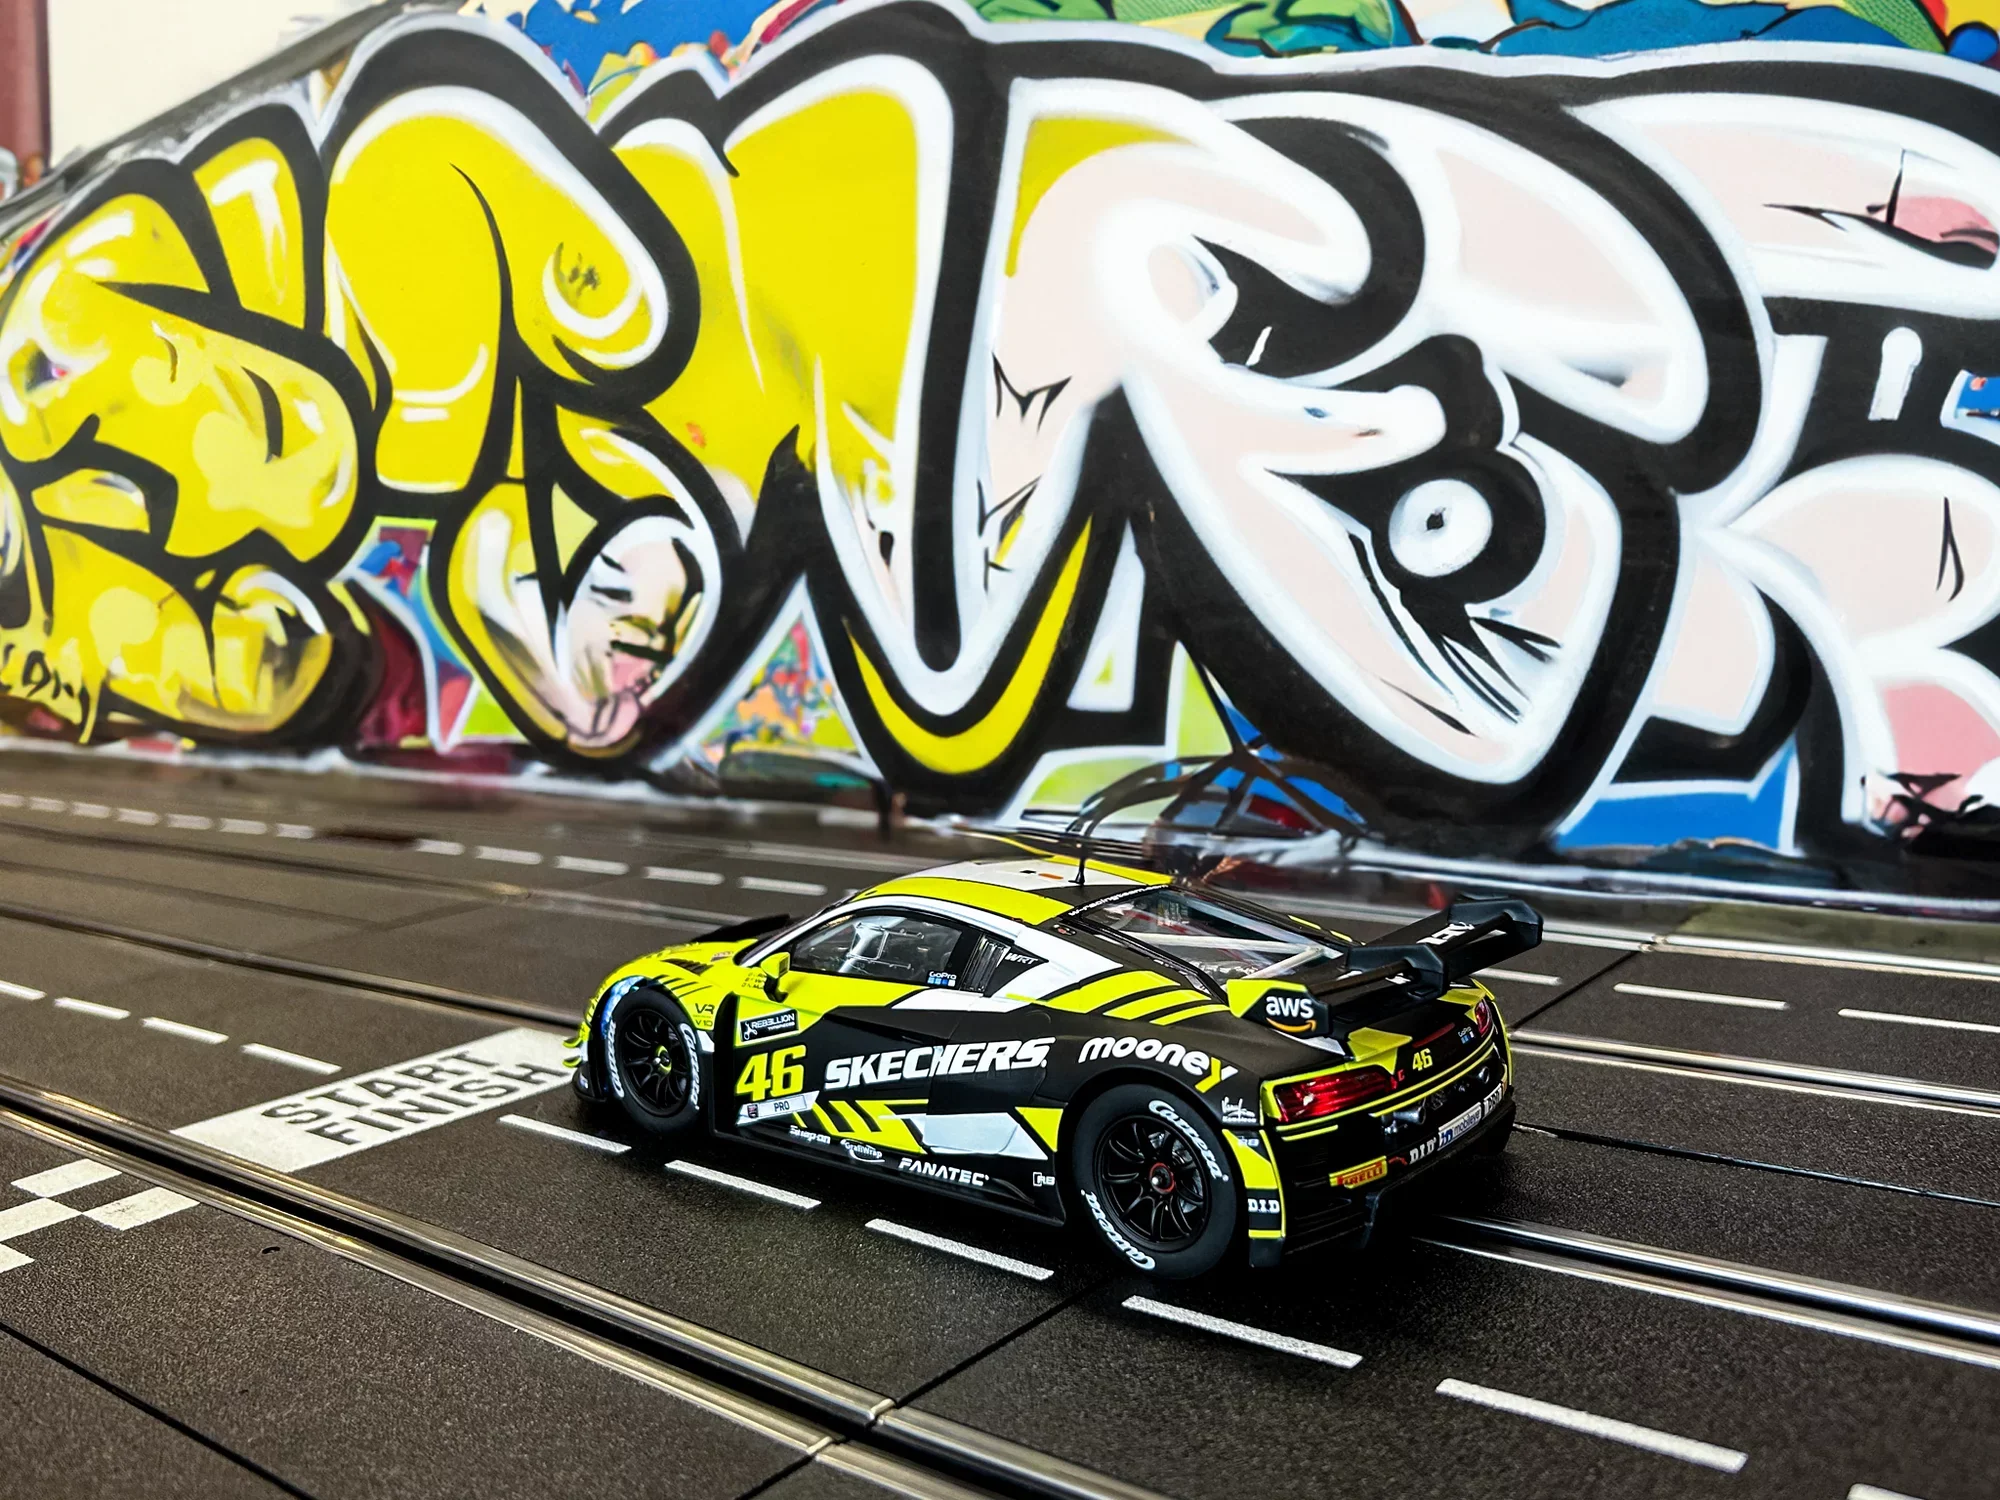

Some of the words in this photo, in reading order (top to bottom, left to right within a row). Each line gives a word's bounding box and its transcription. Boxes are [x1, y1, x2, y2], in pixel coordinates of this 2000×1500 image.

[1004, 952, 1039, 965] WRT
[928, 971, 957, 980] GoPro
[695, 1003, 715, 1015] VR
[1265, 995, 1315, 1019] aws
[751, 1013, 796, 1029] REBELLION
[1458, 1026, 1472, 1038] GoPro
[680, 1022, 700, 1106] Carrera
[1078, 1036, 1239, 1094] mooney
[1412, 1048, 1434, 1071] 46
[736, 1045, 807, 1102] 46
[261, 1050, 500, 1126] START
[305, 1062, 570, 1146] FINISH
[774, 1100, 790, 1113] PRO
[1148, 1099, 1223, 1180] Carrera
[898, 1157, 985, 1187] FANATEC
[1085, 1191, 1156, 1271] Carrera
